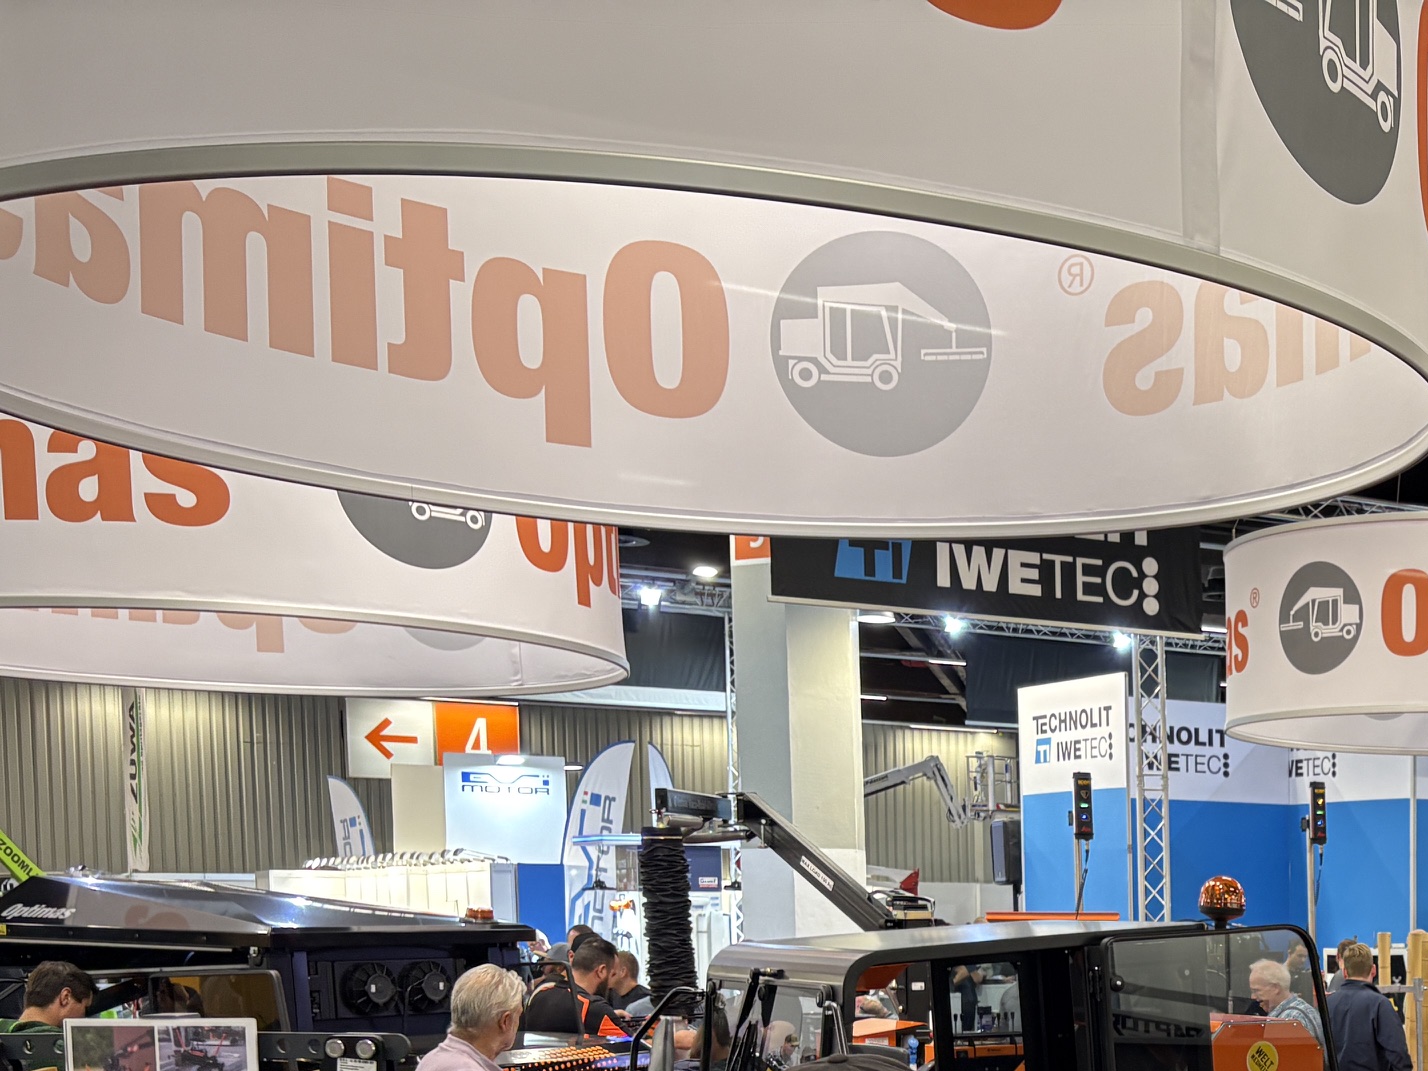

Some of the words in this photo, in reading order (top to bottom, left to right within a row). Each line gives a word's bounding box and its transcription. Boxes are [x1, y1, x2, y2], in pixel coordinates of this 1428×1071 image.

[935, 541, 1140, 607] IWETEC
[465, 717, 493, 753] 4
[1032, 705, 1112, 736] TECHNOLIT
[1056, 733, 1110, 764] IWETEC
[461, 784, 549, 796] MOTOR
[1, 903, 76, 921] Optimas
[1257, 1045, 1275, 1069] WELT
